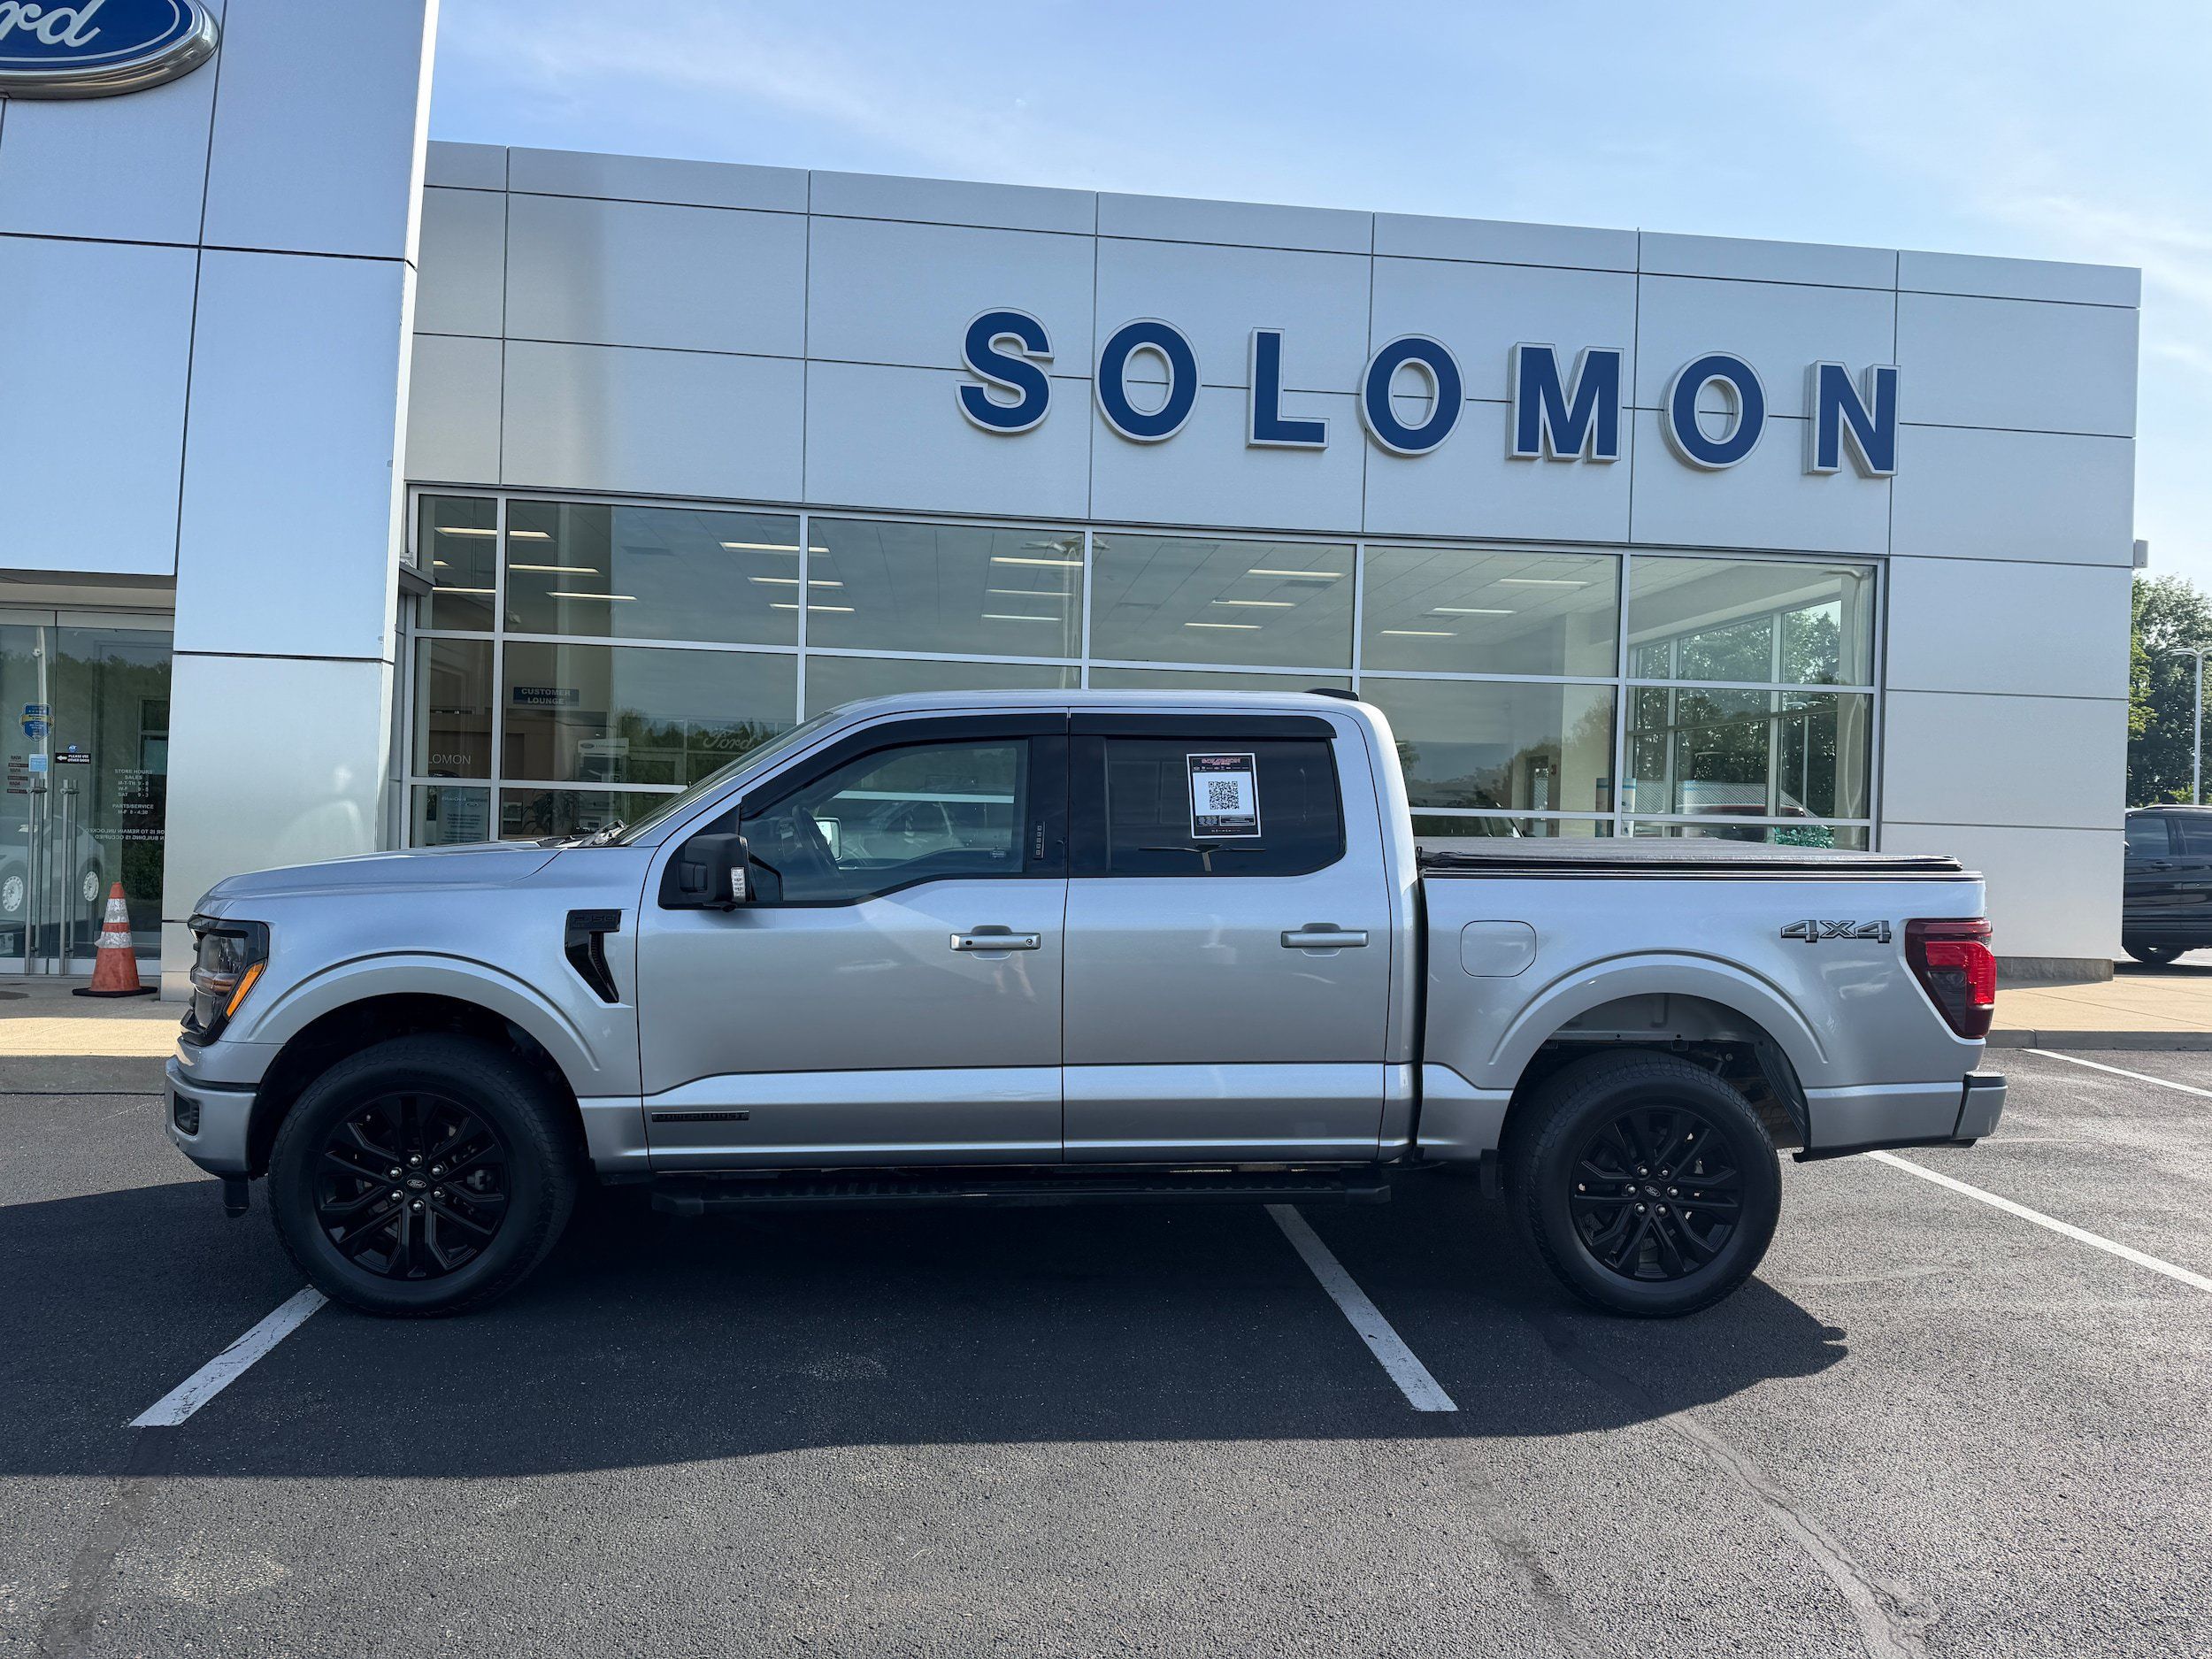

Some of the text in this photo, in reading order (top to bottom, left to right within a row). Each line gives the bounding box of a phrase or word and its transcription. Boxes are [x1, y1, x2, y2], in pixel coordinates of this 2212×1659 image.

[956, 307, 1901, 476] SOLOMON
[521, 687, 571, 696] CUSTOMER
[527, 696, 565, 705] LOUNGE
[702, 726, 755, 750] Ford
